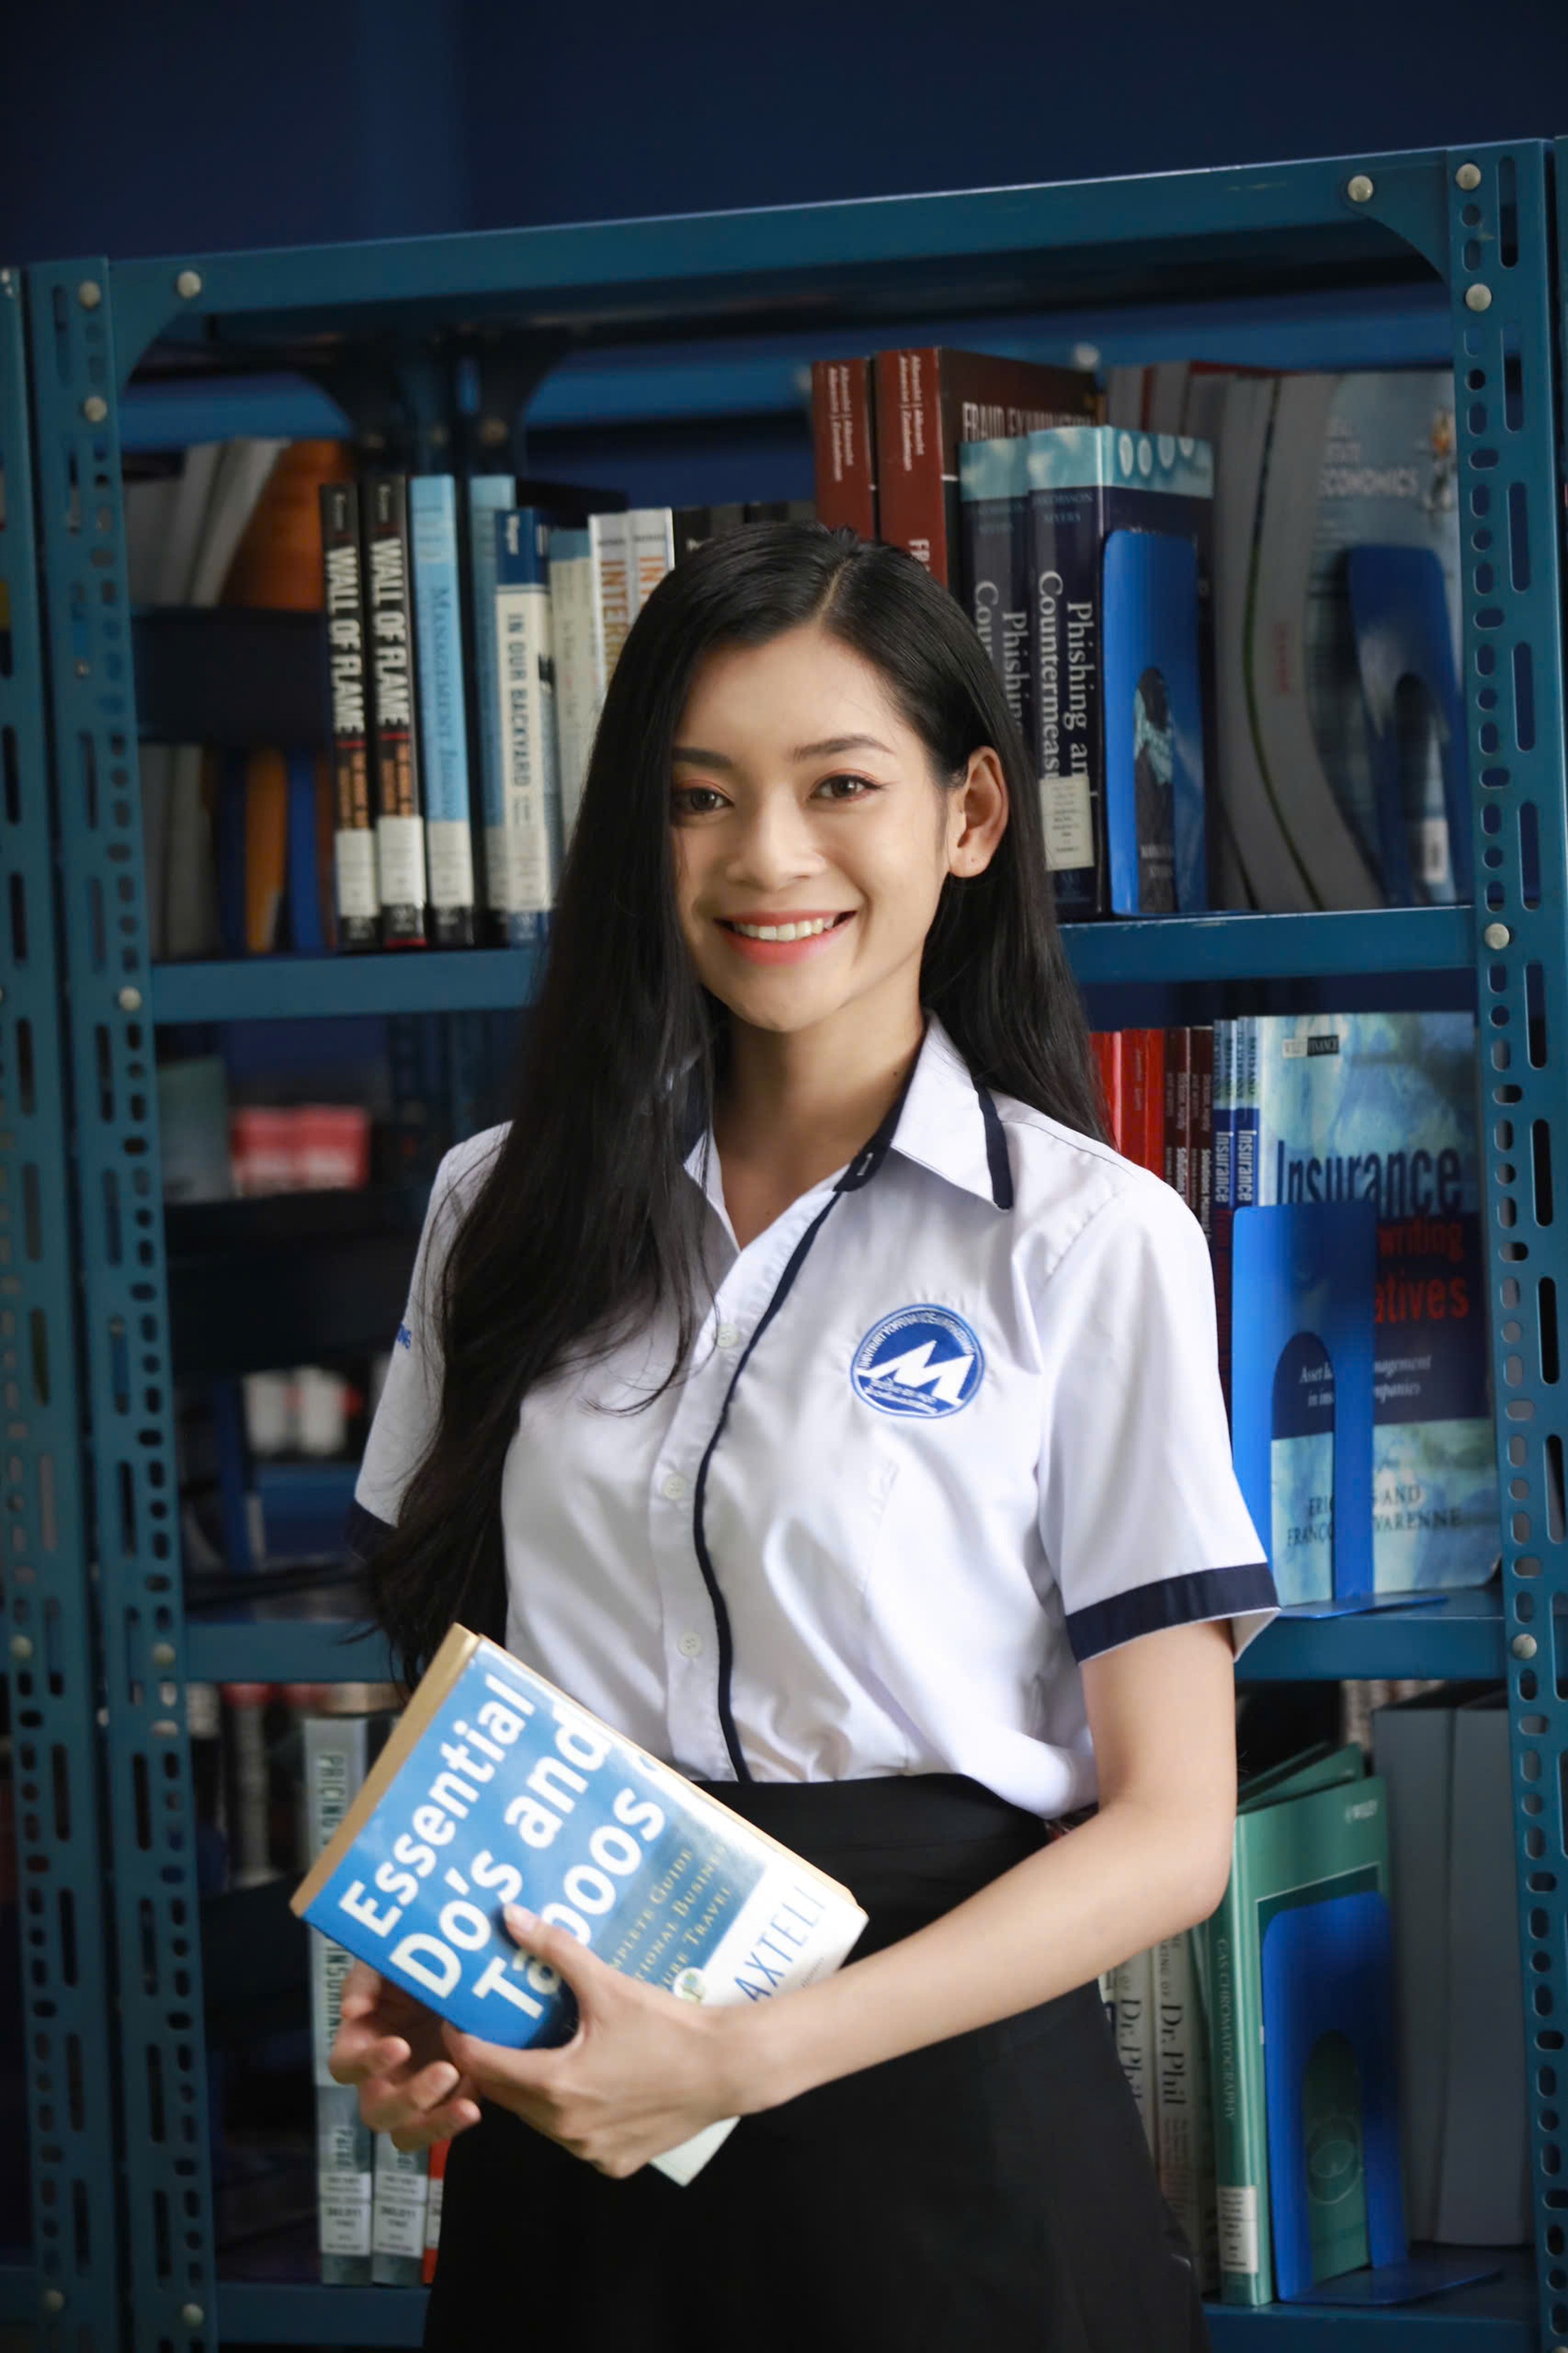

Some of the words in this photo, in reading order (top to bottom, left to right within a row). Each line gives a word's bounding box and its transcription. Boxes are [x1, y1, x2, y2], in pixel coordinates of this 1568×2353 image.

[327, 546, 359, 616] WALL
[370, 537, 403, 607] WALL
[330, 618, 361, 650] OF
[375, 611, 407, 643] OF
[508, 613, 523, 634] IN
[331, 654, 365, 734] FLAME
[376, 646, 410, 727] FLAME
[509, 641, 527, 681] OUR
[1002, 611, 1030, 726] Phishin
[1038, 570, 1063, 778] Countermeas
[1062, 601, 1095, 730] Phishing
[511, 689, 530, 787] BACKYARD
[1215, 1131, 1234, 1203] Insurance
[1238, 1129, 1257, 1202] Insurance
[1276, 1139, 1464, 1217] Insurance
[1376, 1218, 1465, 1263] writing
[1374, 1268, 1469, 1324] atives
[1373, 1355, 1432, 1379] nagement
[338, 1673, 536, 1938] Essential
[390, 1850, 523, 1999] Do's
[503, 1703, 612, 1849] and
[1120, 1999, 1141, 2038] Dr.
[1160, 2004, 1183, 2044] Dr.
[1162, 2052, 1187, 2105] Phil
